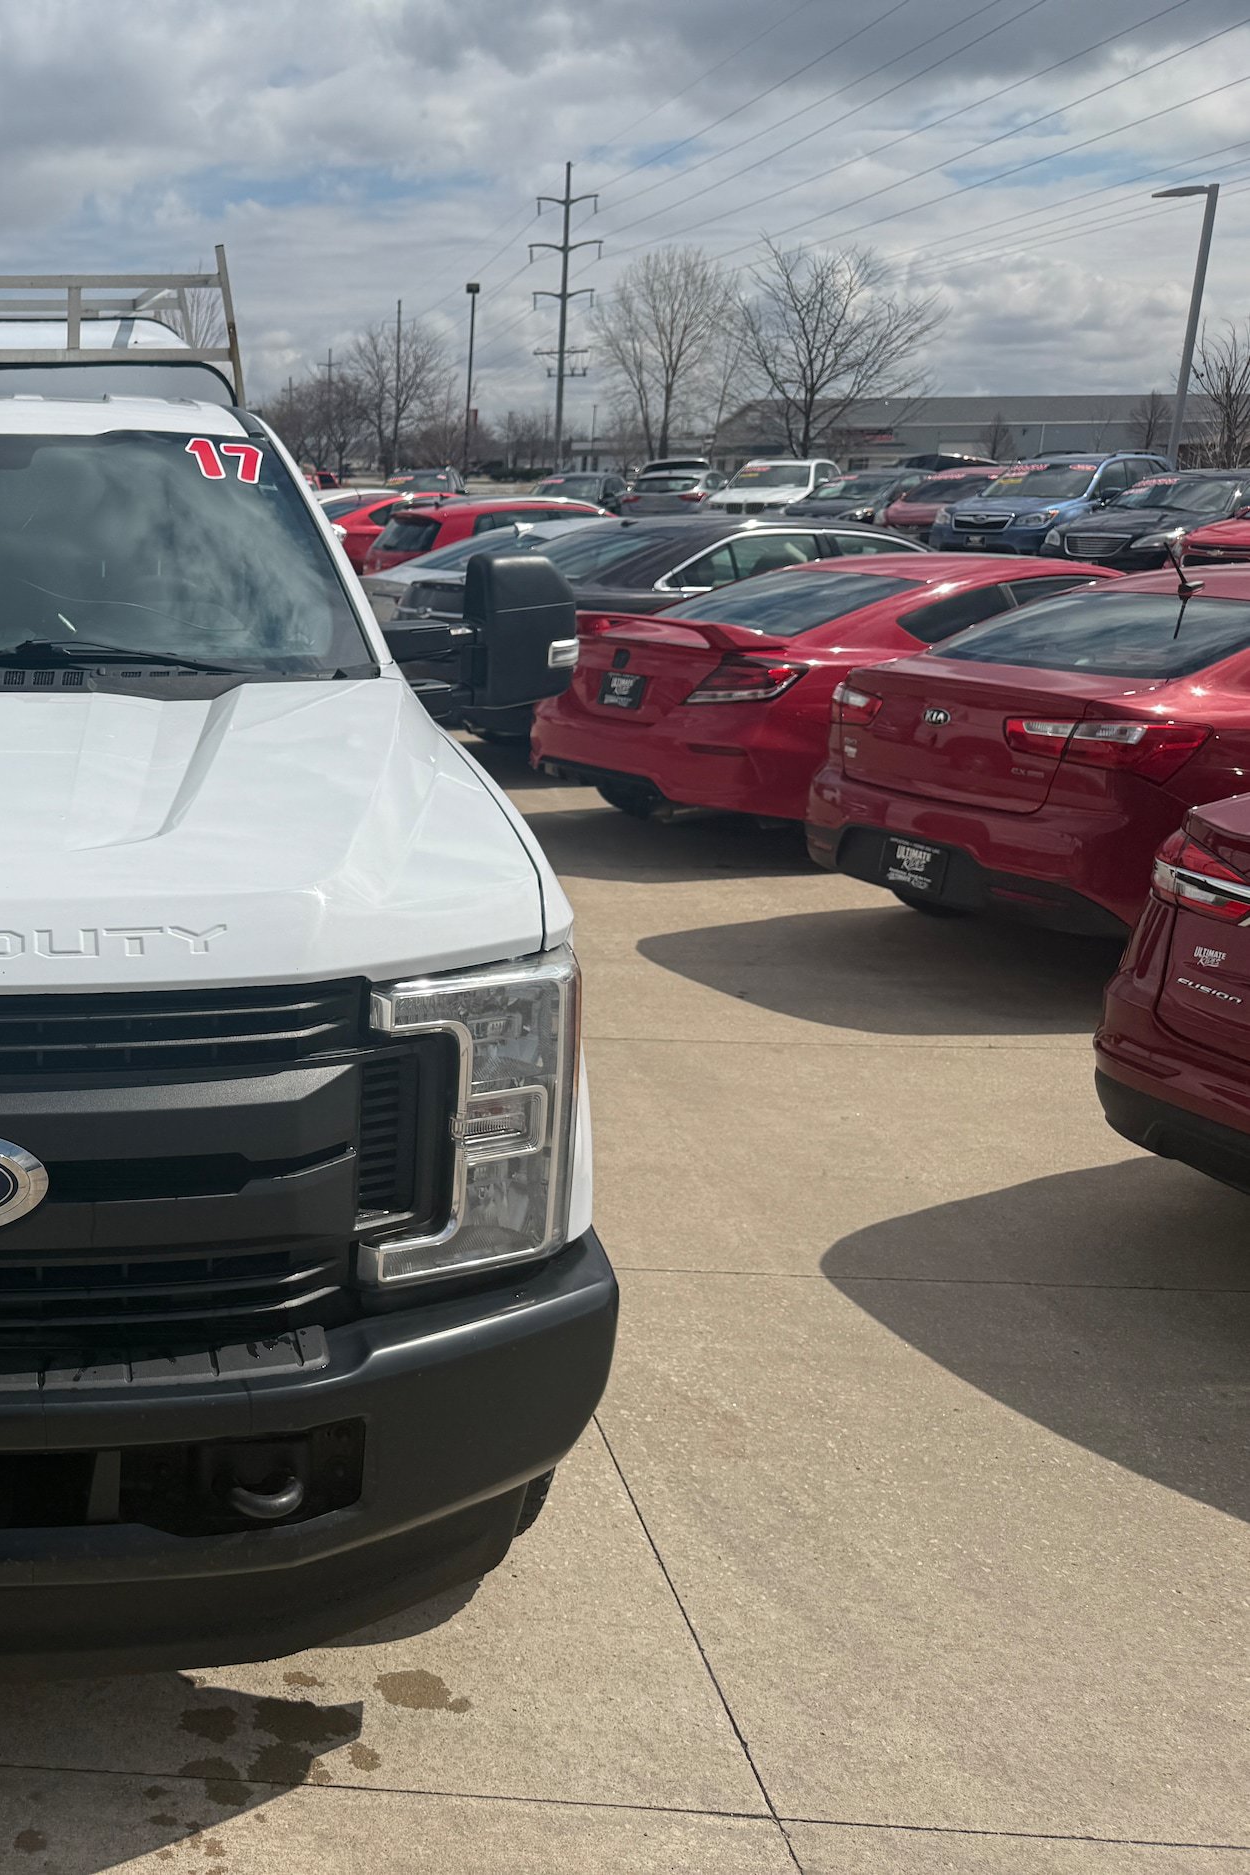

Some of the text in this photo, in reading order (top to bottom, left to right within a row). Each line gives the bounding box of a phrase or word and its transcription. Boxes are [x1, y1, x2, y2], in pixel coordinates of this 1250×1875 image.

[185, 438, 263, 484] 17
[924, 710, 946, 722] KIA
[896, 844, 931, 863] ULTIMATE
[1193, 946, 1227, 960] ULTIMATE
